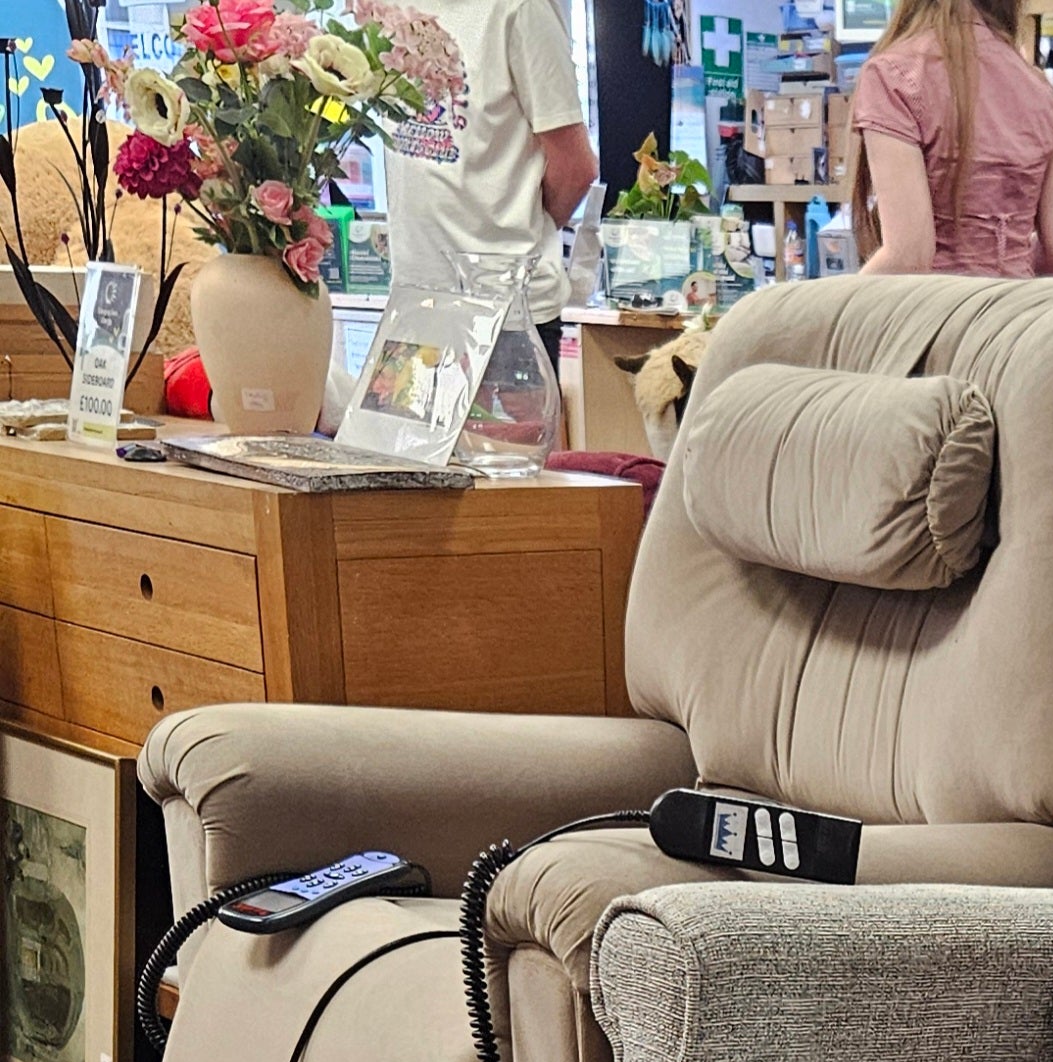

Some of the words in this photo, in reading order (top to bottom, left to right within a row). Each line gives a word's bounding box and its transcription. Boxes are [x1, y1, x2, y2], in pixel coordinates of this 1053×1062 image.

[94, 357, 107, 369] OAK
[82, 373, 115, 389] SIDEBOARD
[79, 395, 113, 417] £100.00
